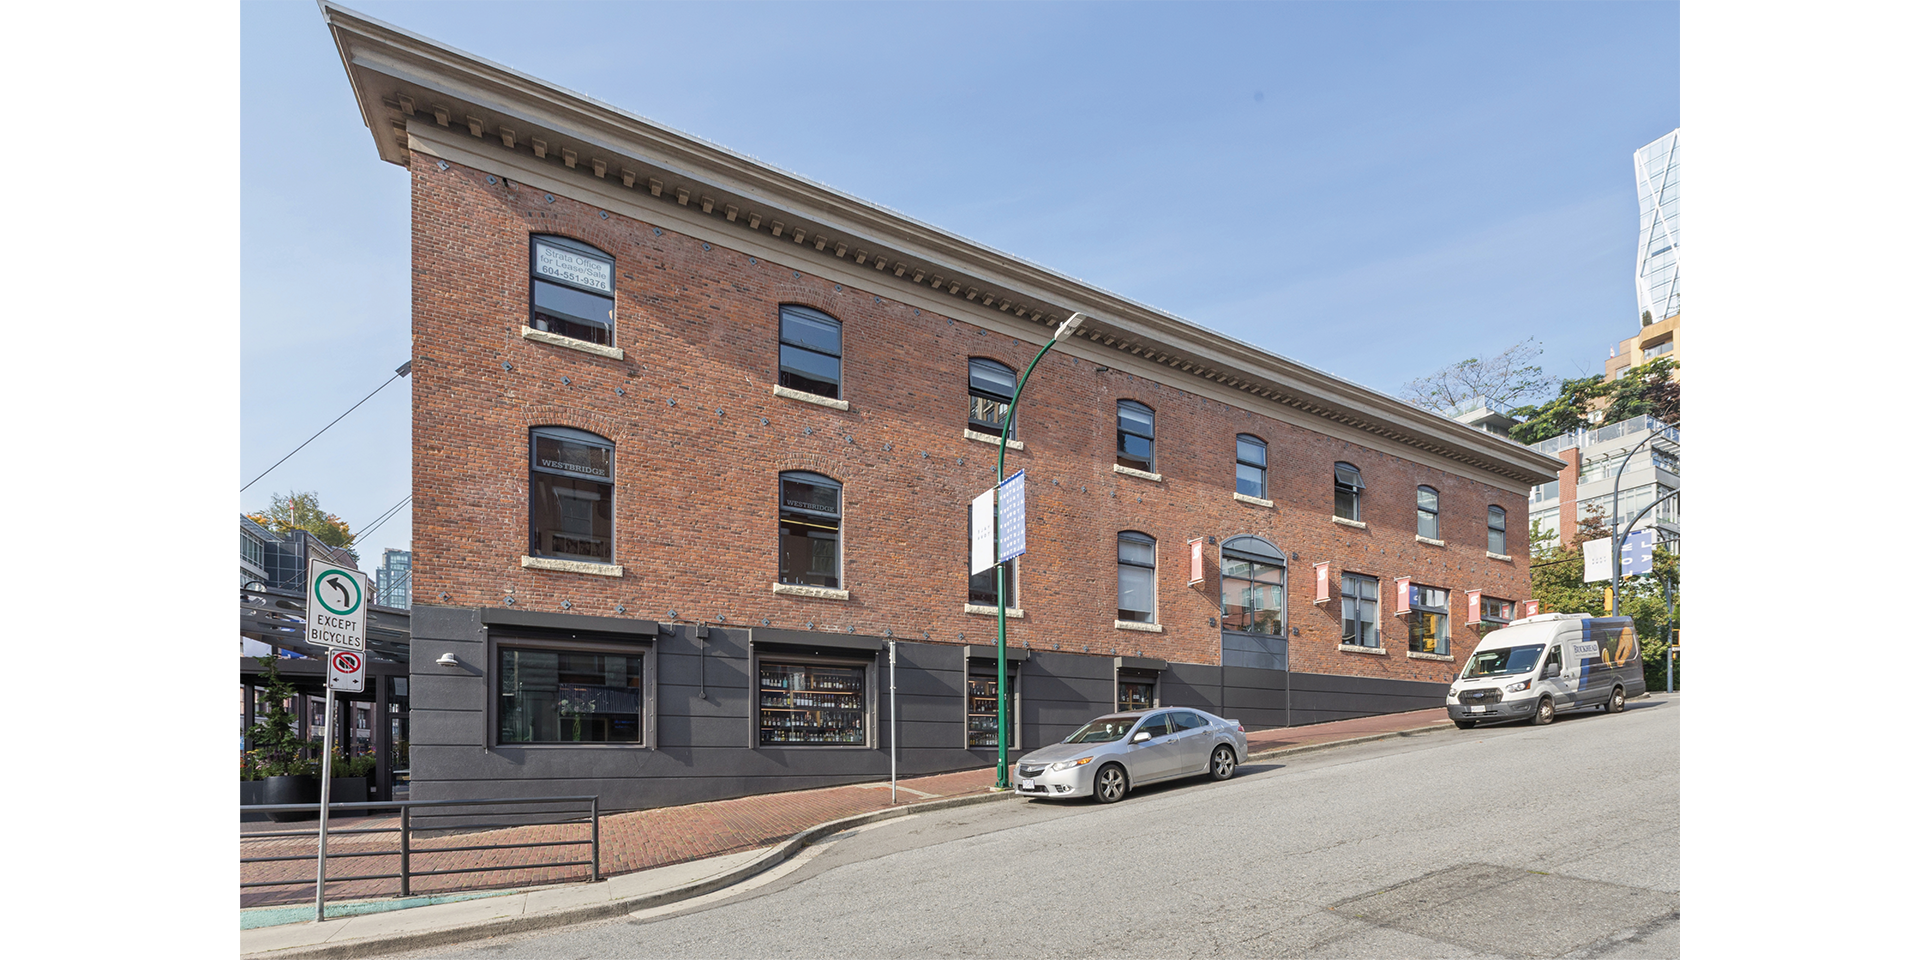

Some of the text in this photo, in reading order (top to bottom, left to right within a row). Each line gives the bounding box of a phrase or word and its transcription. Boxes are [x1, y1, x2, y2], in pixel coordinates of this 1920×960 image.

[540, 254, 607, 280] for Lease/Sale
[545, 248, 602, 271] Strata Office
[542, 265, 606, 289] 604-551-9376
[541, 459, 605, 476] WESTBRIDGE
[786, 499, 835, 512] WESTBRIDGE
[317, 614, 357, 631] EXCEPT
[311, 628, 361, 647] BICYCLES
